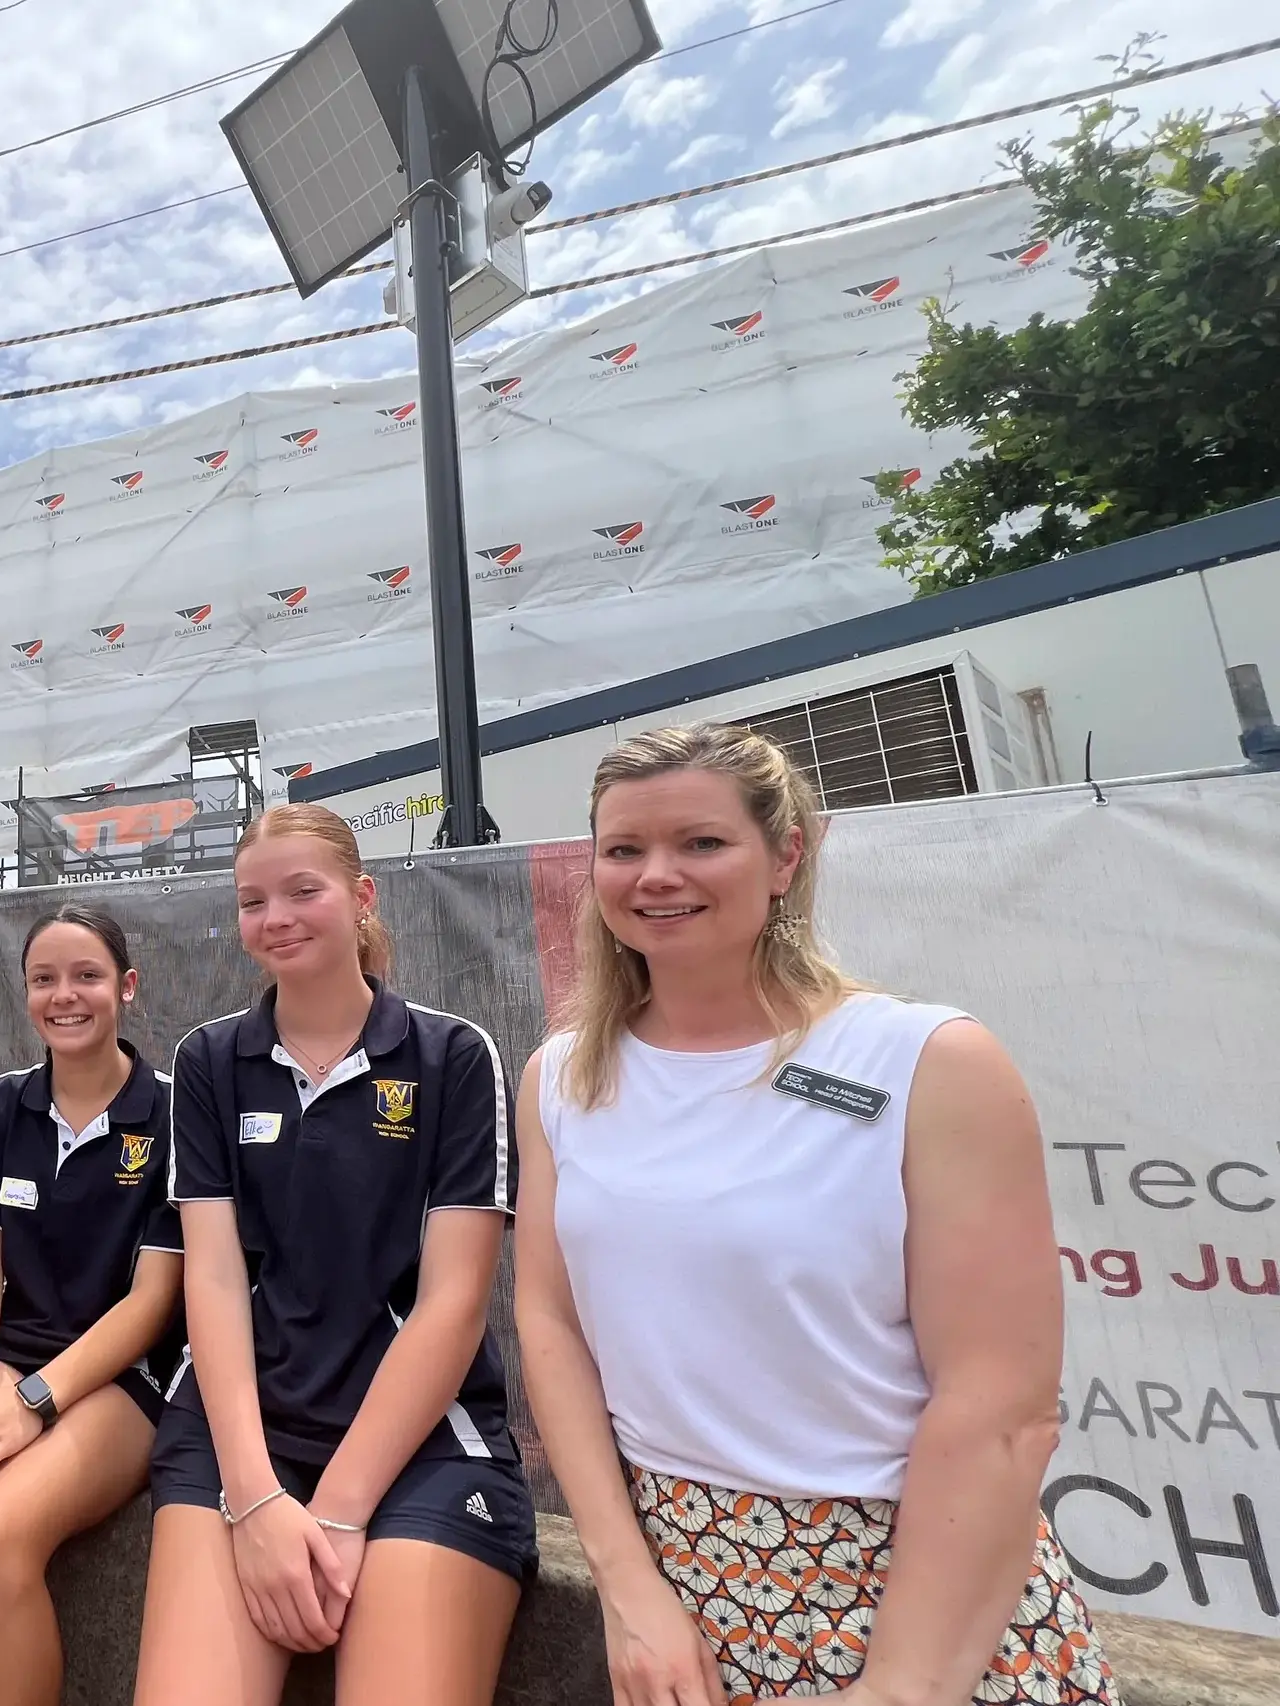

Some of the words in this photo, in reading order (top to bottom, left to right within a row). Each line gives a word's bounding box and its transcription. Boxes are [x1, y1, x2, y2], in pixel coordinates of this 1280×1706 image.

[843, 299, 903, 319] BLASTONE
[711, 330, 766, 352] BLASTONE
[589, 362, 640, 380] BLASTONE
[374, 418, 417, 434] BLASTONE
[279, 445, 318, 461] BLASTONE
[721, 517, 779, 535] BLASTONE
[593, 544, 645, 560] BLASTONE
[475, 564, 524, 580] BLASTONE
[367, 587, 411, 602] BLASTONE
[267, 606, 308, 620] BLASTONE
[175, 624, 211, 637] BLASTONE
[90, 642, 125, 654] BLASTONE
[11, 657, 44, 669] BLASTONE
[781, 1080, 809, 1092] SCHOOL
[786, 1074, 803, 1083] TECH
[839, 1089, 872, 1102] Mitchell
[245, 1121, 264, 1137] Elke
[1052, 1140, 1280, 1213] Tec
[1058, 1246, 1142, 1298] ng
[1170, 1243, 1280, 1296] Ju
[1059, 1377, 1280, 1450] ARAT
[1040, 1474, 1280, 1618] CH
